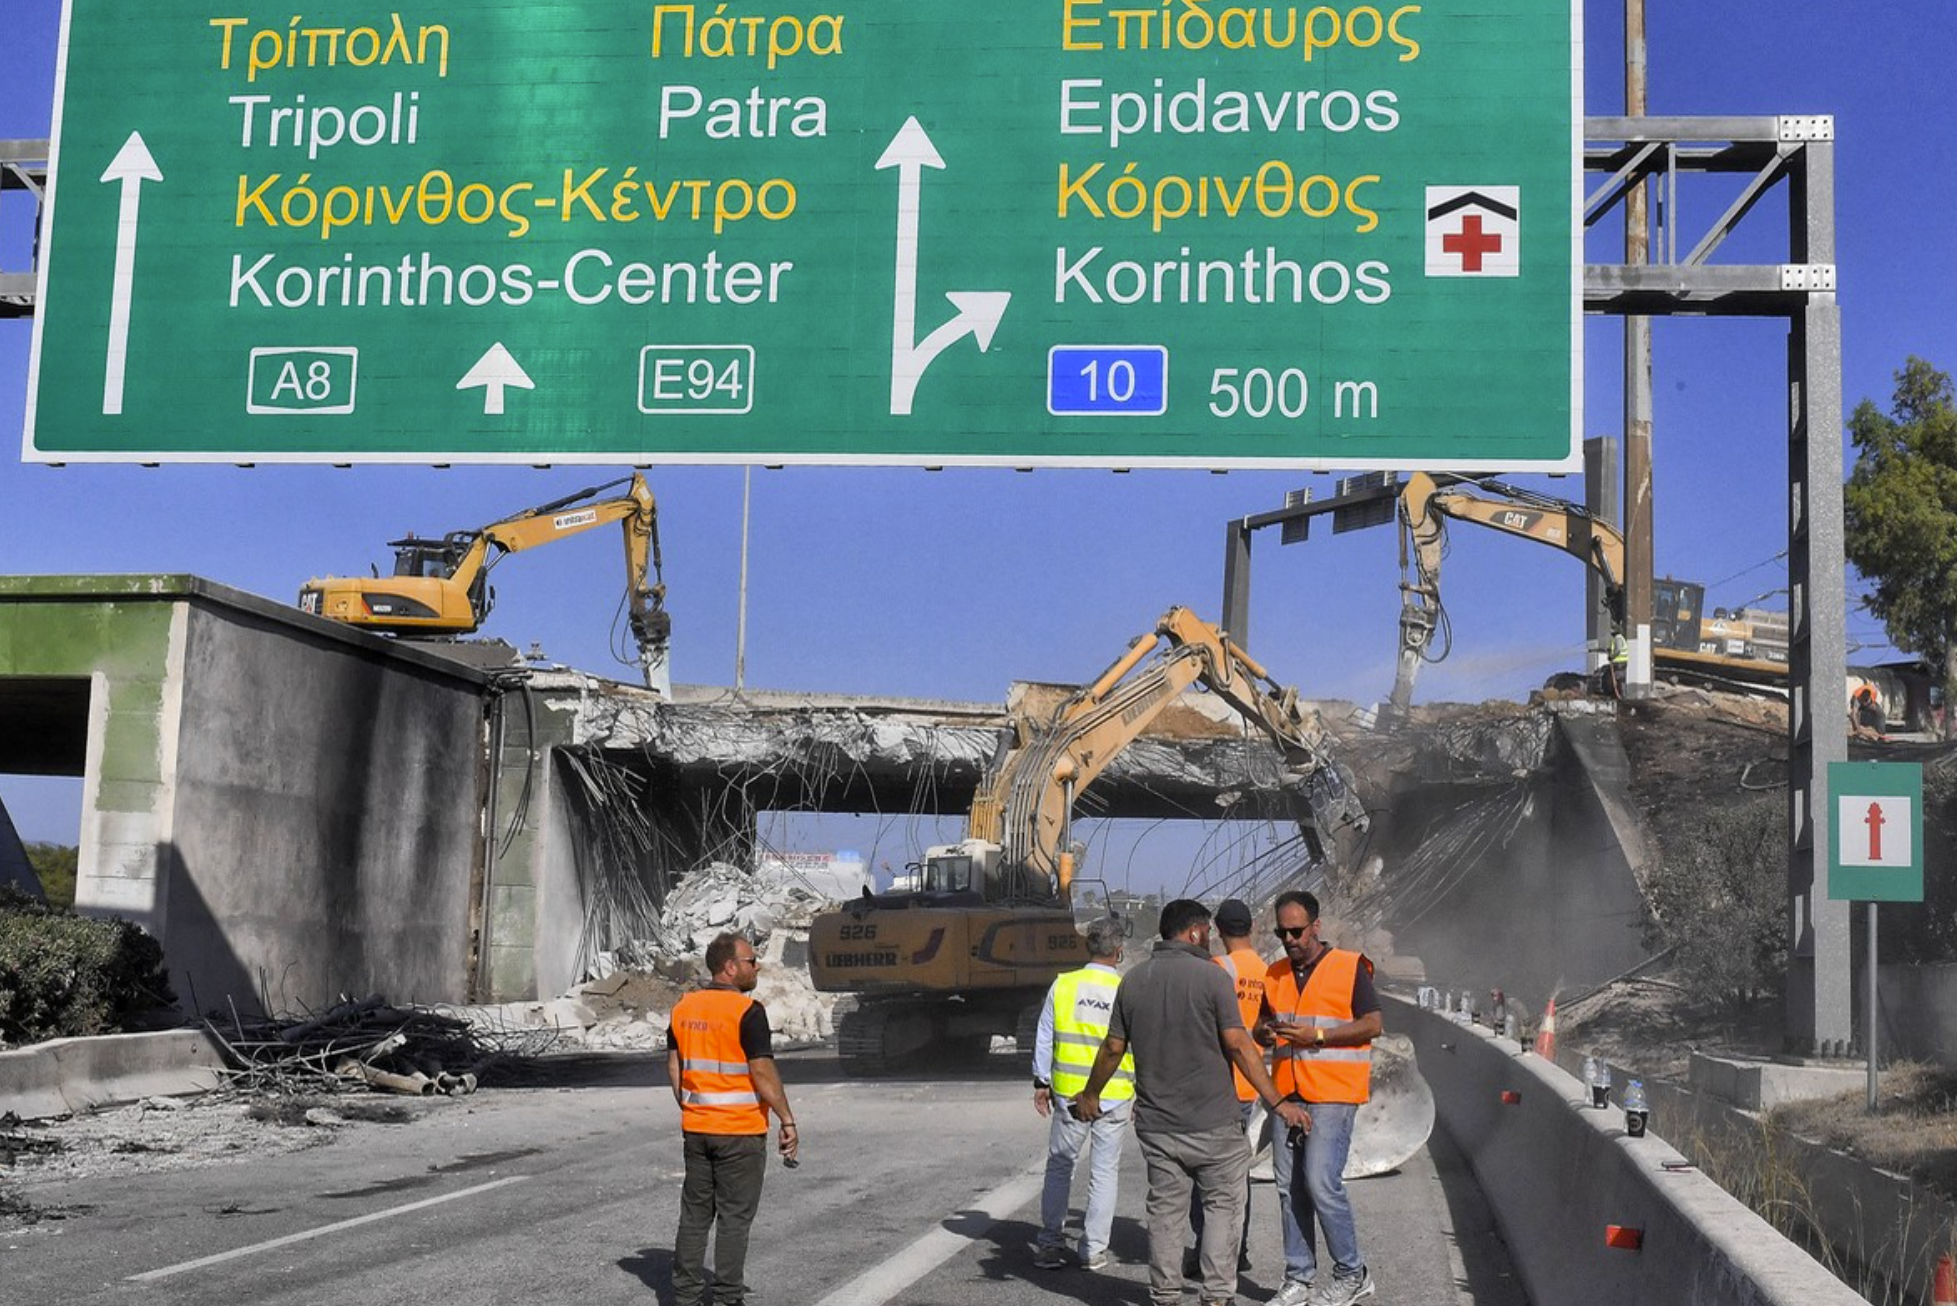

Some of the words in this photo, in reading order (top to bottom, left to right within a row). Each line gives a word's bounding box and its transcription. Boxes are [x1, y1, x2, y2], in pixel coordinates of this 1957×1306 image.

[210, 13, 449, 82] Τρίπολη
[652, 4, 845, 69] Πάτρα
[1062, 0, 1421, 62] Επίδαυρος
[229, 92, 419, 159] Tripoli
[659, 86, 827, 139] Patra
[1060, 78, 1400, 148] Epidavros
[235, 167, 797, 239] Κόρινθος-Κέντρο
[1057, 160, 1381, 232] Κόρινθος
[229, 249, 794, 308] Korinthos-Center
[1055, 247, 1391, 304] Korinthos
[271, 361, 331, 400] A8
[653, 359, 743, 400] E94
[1080, 360, 1136, 401] 10
[1209, 368, 1308, 418] 500
[1334, 382, 1378, 418] m
[1504, 511, 1528, 530] CAT
[300, 592, 318, 615] CAT
[1699, 641, 1718, 654] CAT
[839, 924, 878, 941] 926
[1047, 934, 1077, 950] 926
[825, 950, 897, 968] LIEBHERR
[1077, 998, 1110, 1012] AVAX
